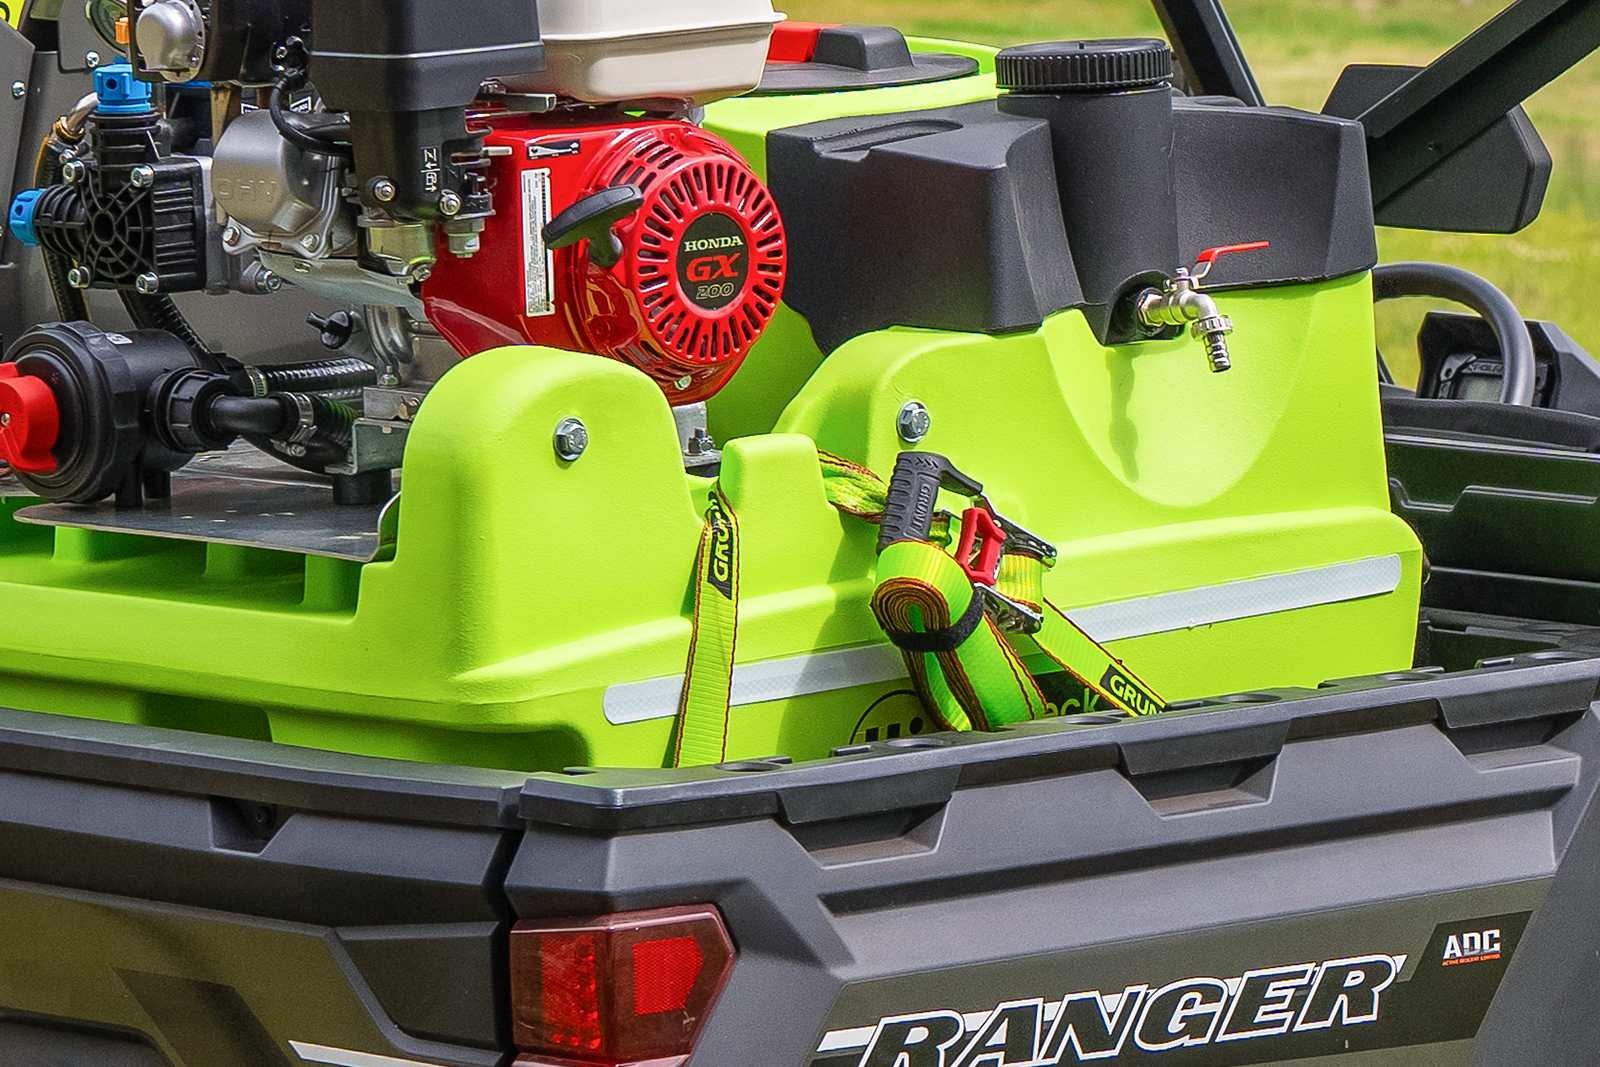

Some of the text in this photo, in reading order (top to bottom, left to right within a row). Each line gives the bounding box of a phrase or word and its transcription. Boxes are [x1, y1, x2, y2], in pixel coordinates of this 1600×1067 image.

[684, 235, 743, 252] HONDA
[686, 252, 741, 282] GX
[695, 282, 734, 300] 200
[912, 483, 931, 532] GRUNT
[1109, 674, 1162, 715] GRUN
[1443, 928, 1501, 959] ADC
[859, 953, 1397, 1067] RANGER
